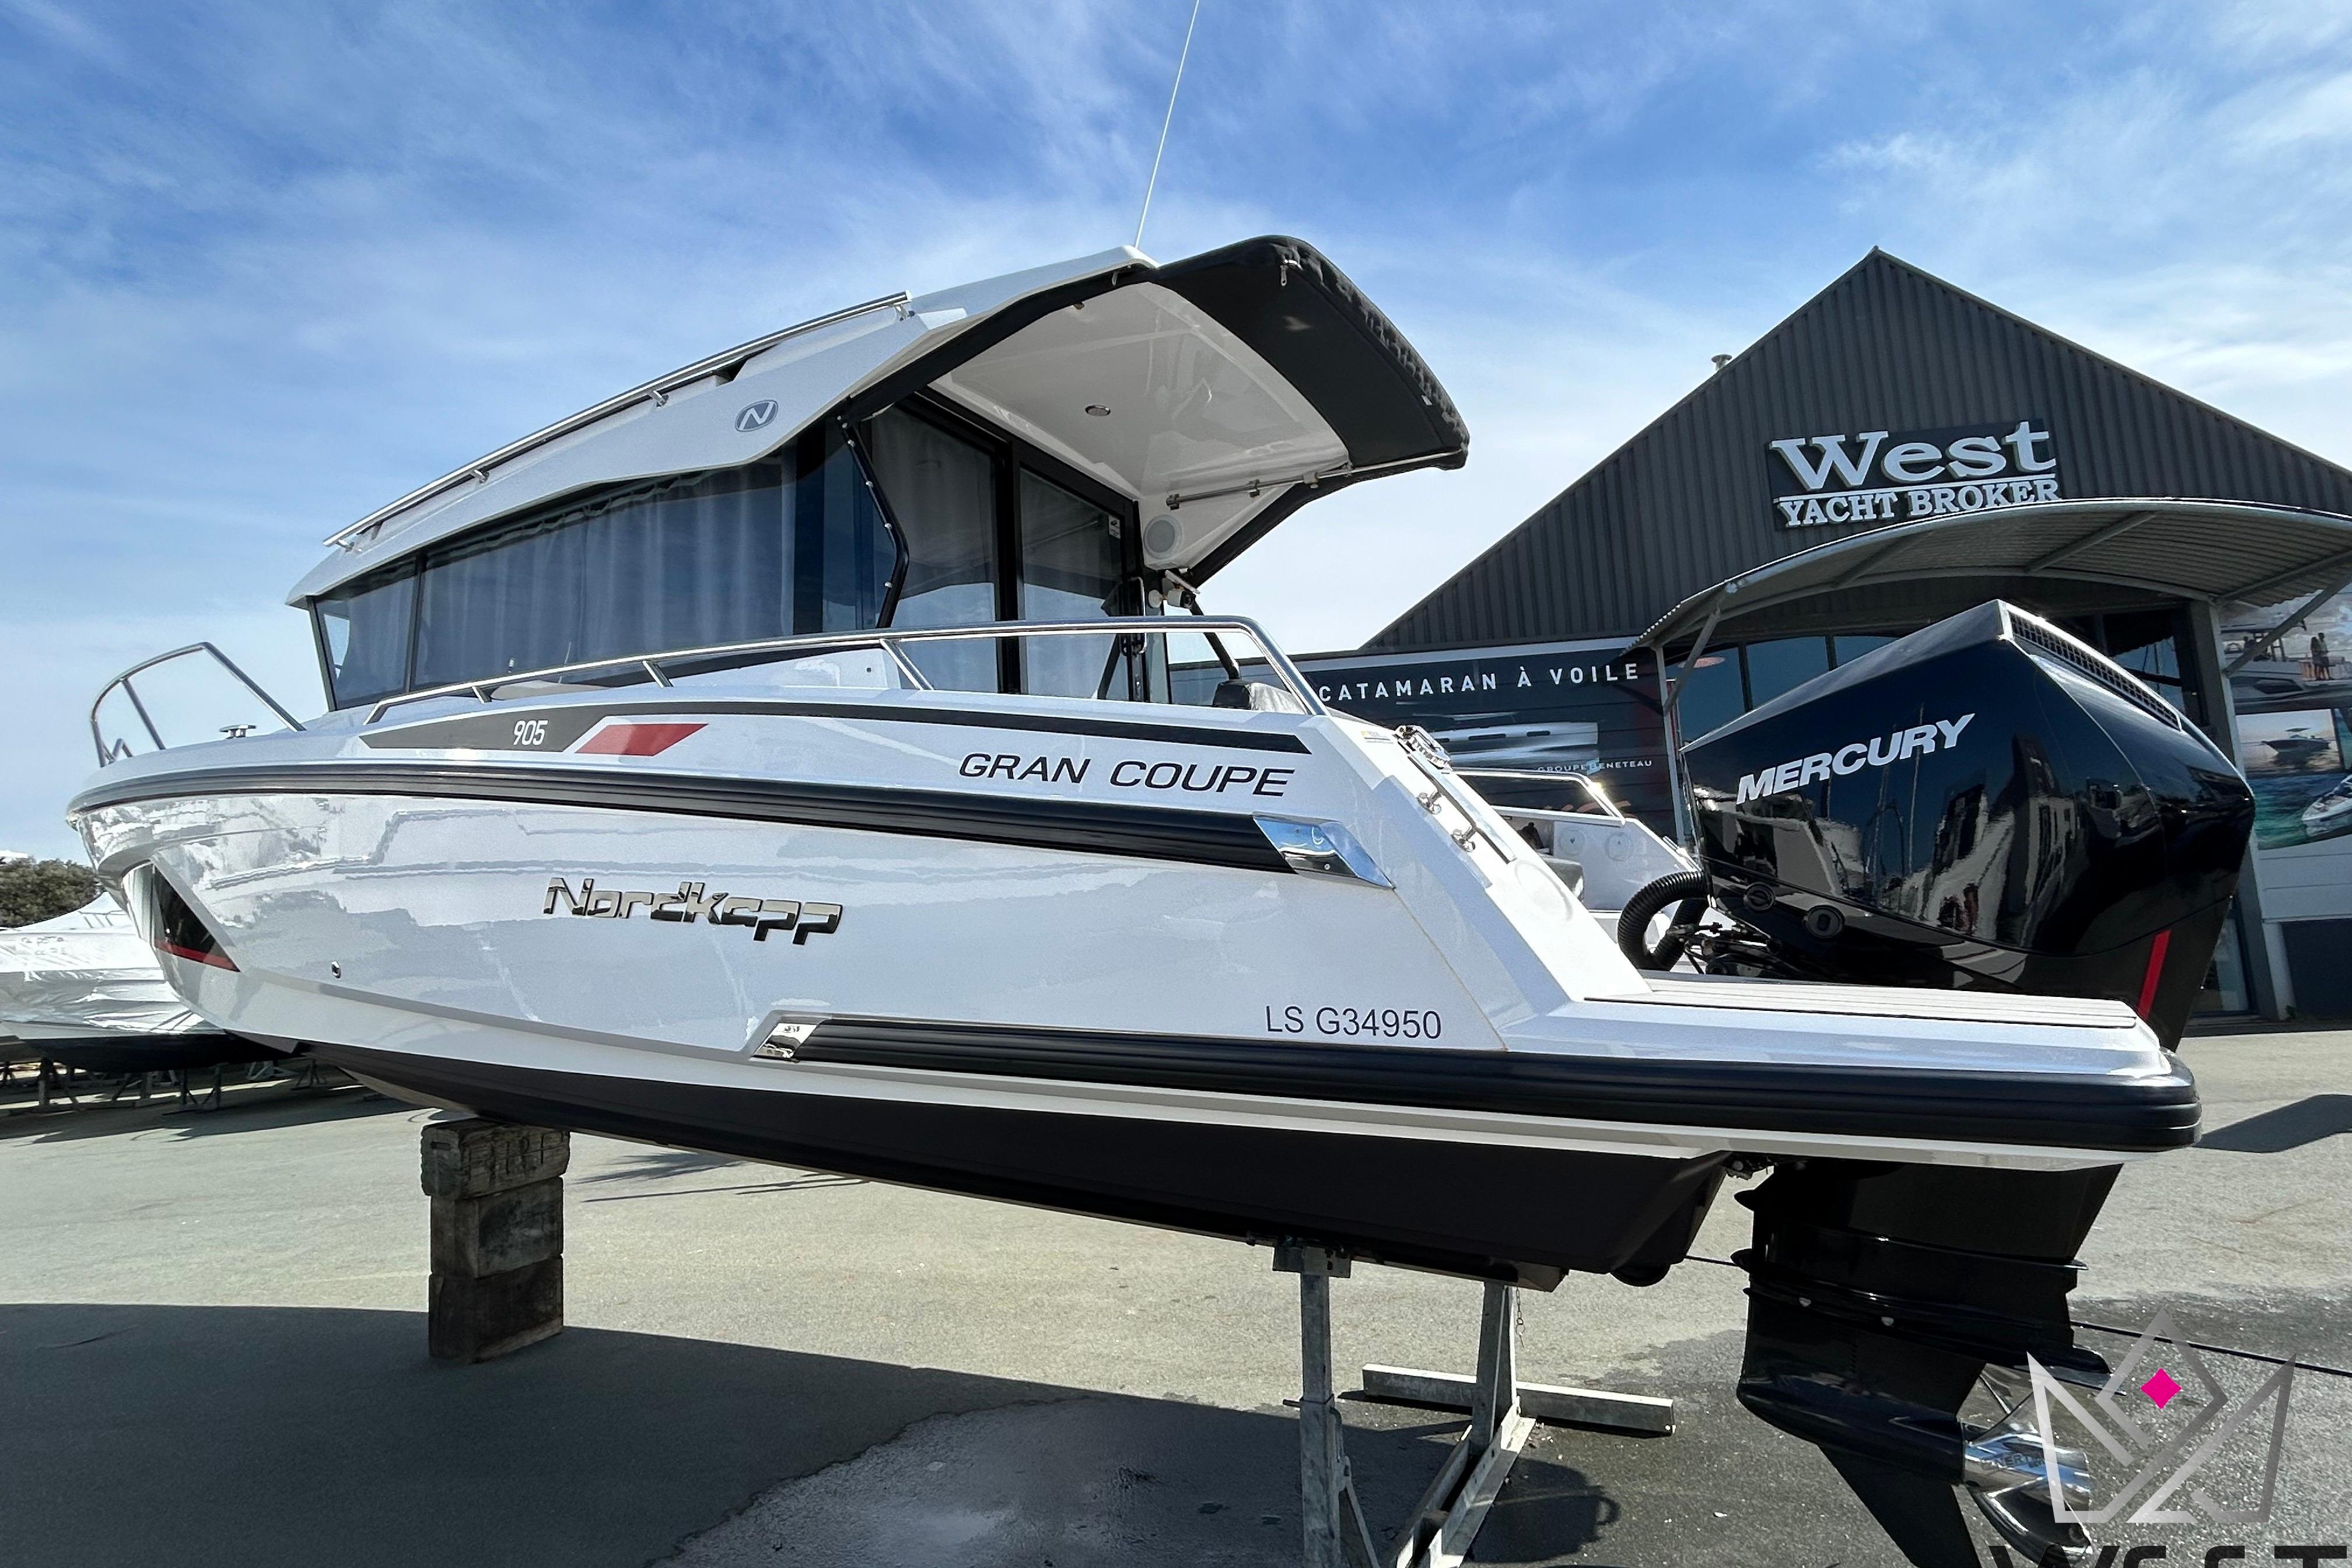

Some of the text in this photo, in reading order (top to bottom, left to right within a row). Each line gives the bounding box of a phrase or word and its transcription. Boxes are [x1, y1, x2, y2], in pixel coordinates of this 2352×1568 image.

[1769, 421, 2057, 491] West
[1777, 478, 2063, 527] YACHT BROKER
[1318, 663, 1638, 702] CATAMARAN À VOILE
[513, 720, 548, 746] 905
[959, 753, 1295, 797] GRAN COUPE
[1538, 764, 1587, 772] GROUPE
[1736, 713, 1975, 805] MERCURY
[1266, 1006, 1441, 1040] LS G34950
